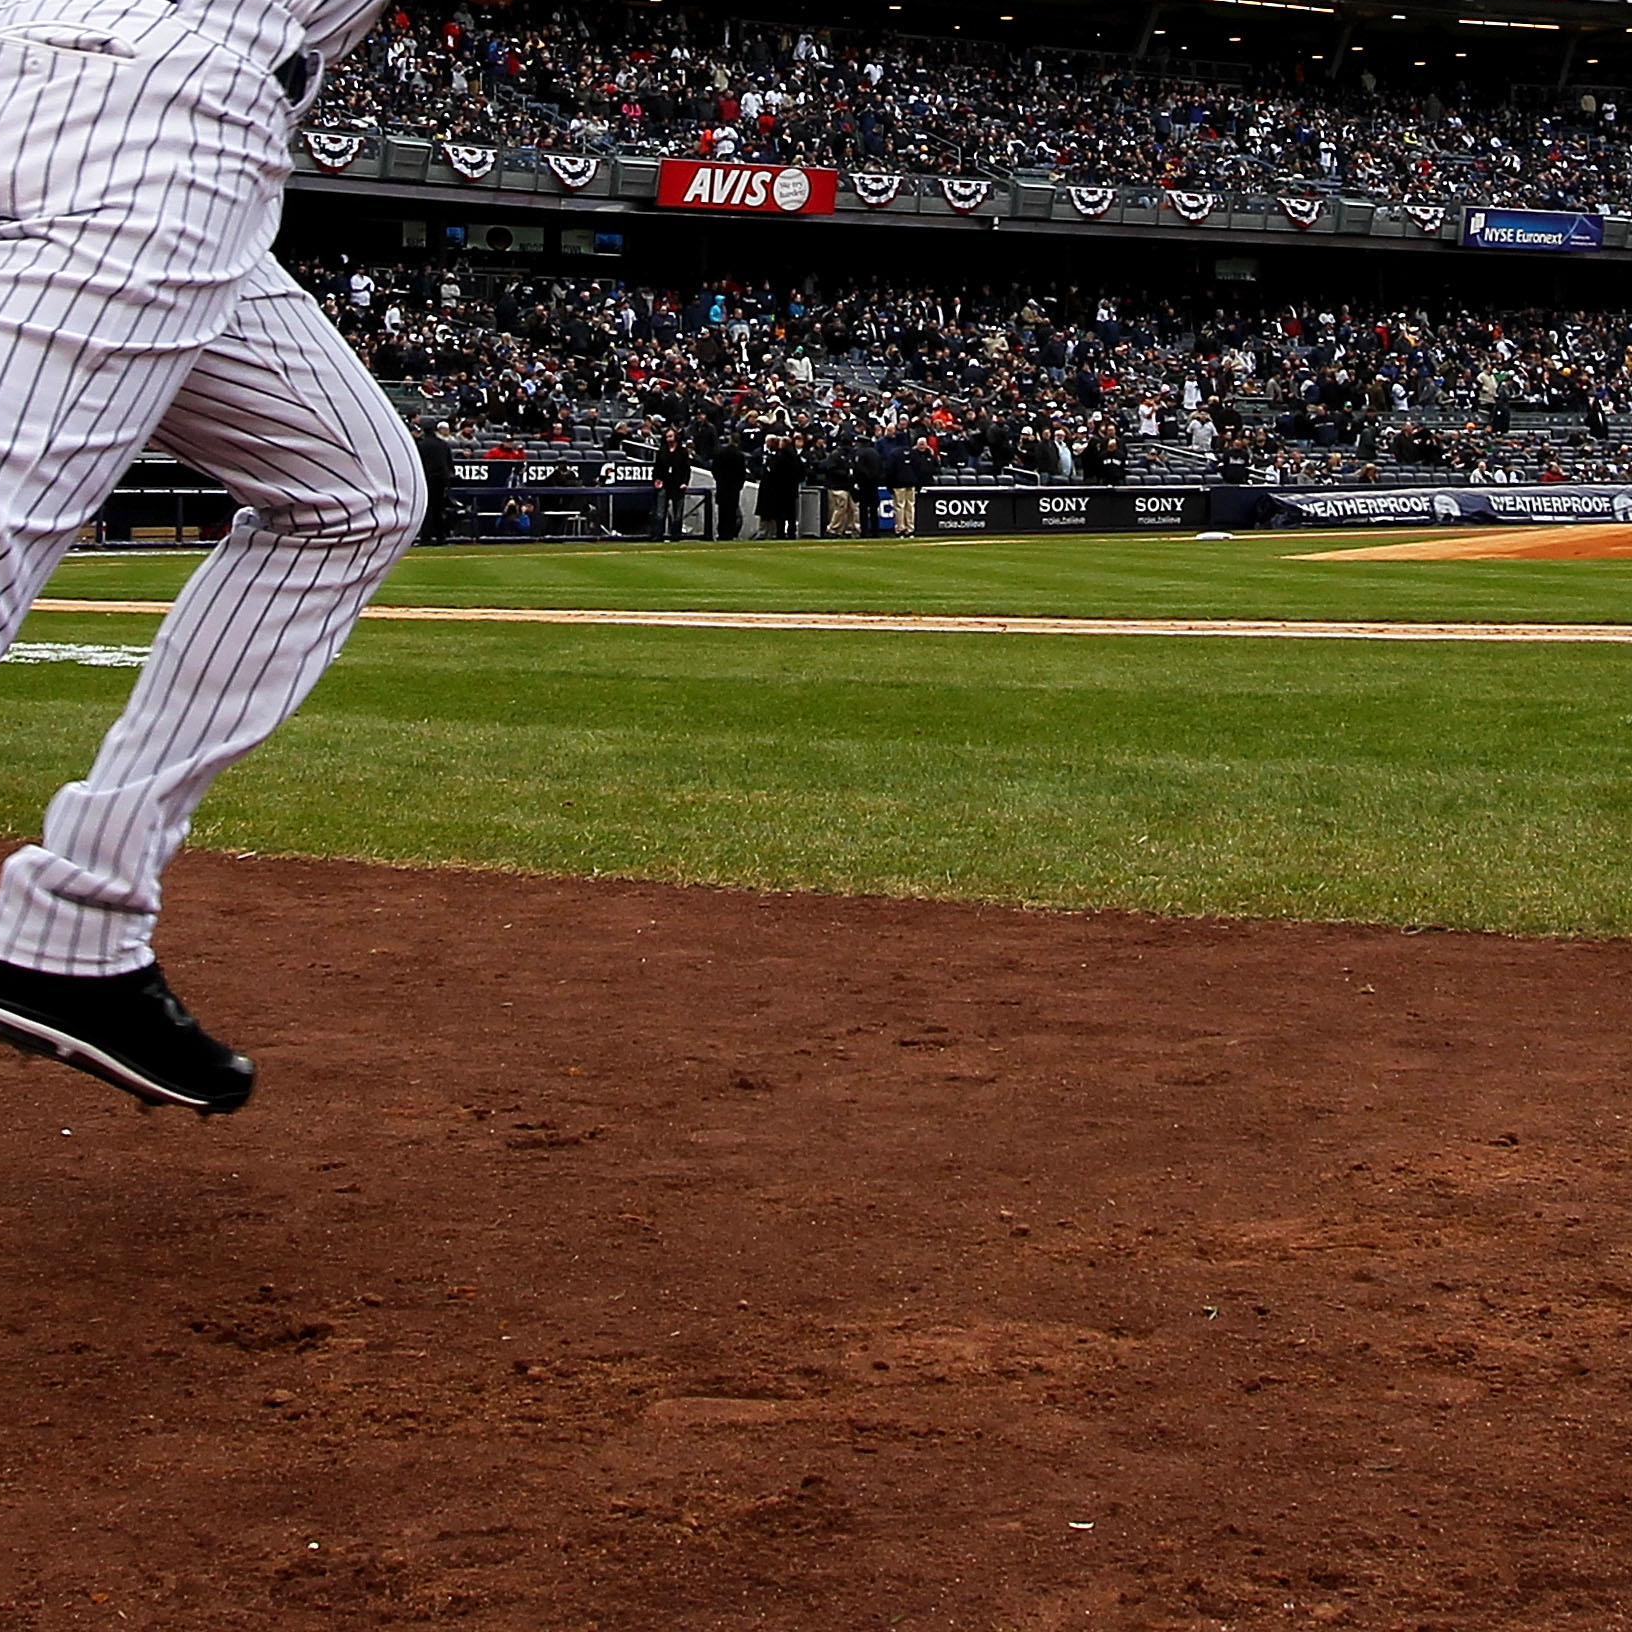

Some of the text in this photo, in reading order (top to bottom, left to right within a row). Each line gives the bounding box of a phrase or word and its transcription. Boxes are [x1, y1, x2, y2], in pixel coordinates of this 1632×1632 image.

[683, 167, 772, 207] AVIS
[1484, 227, 1514, 243] NYSE
[1516, 229, 1563, 246] Euronext
[935, 500, 990, 516] SONY
[1039, 497, 1090, 512] SONY
[1135, 497, 1185, 512] SONY
